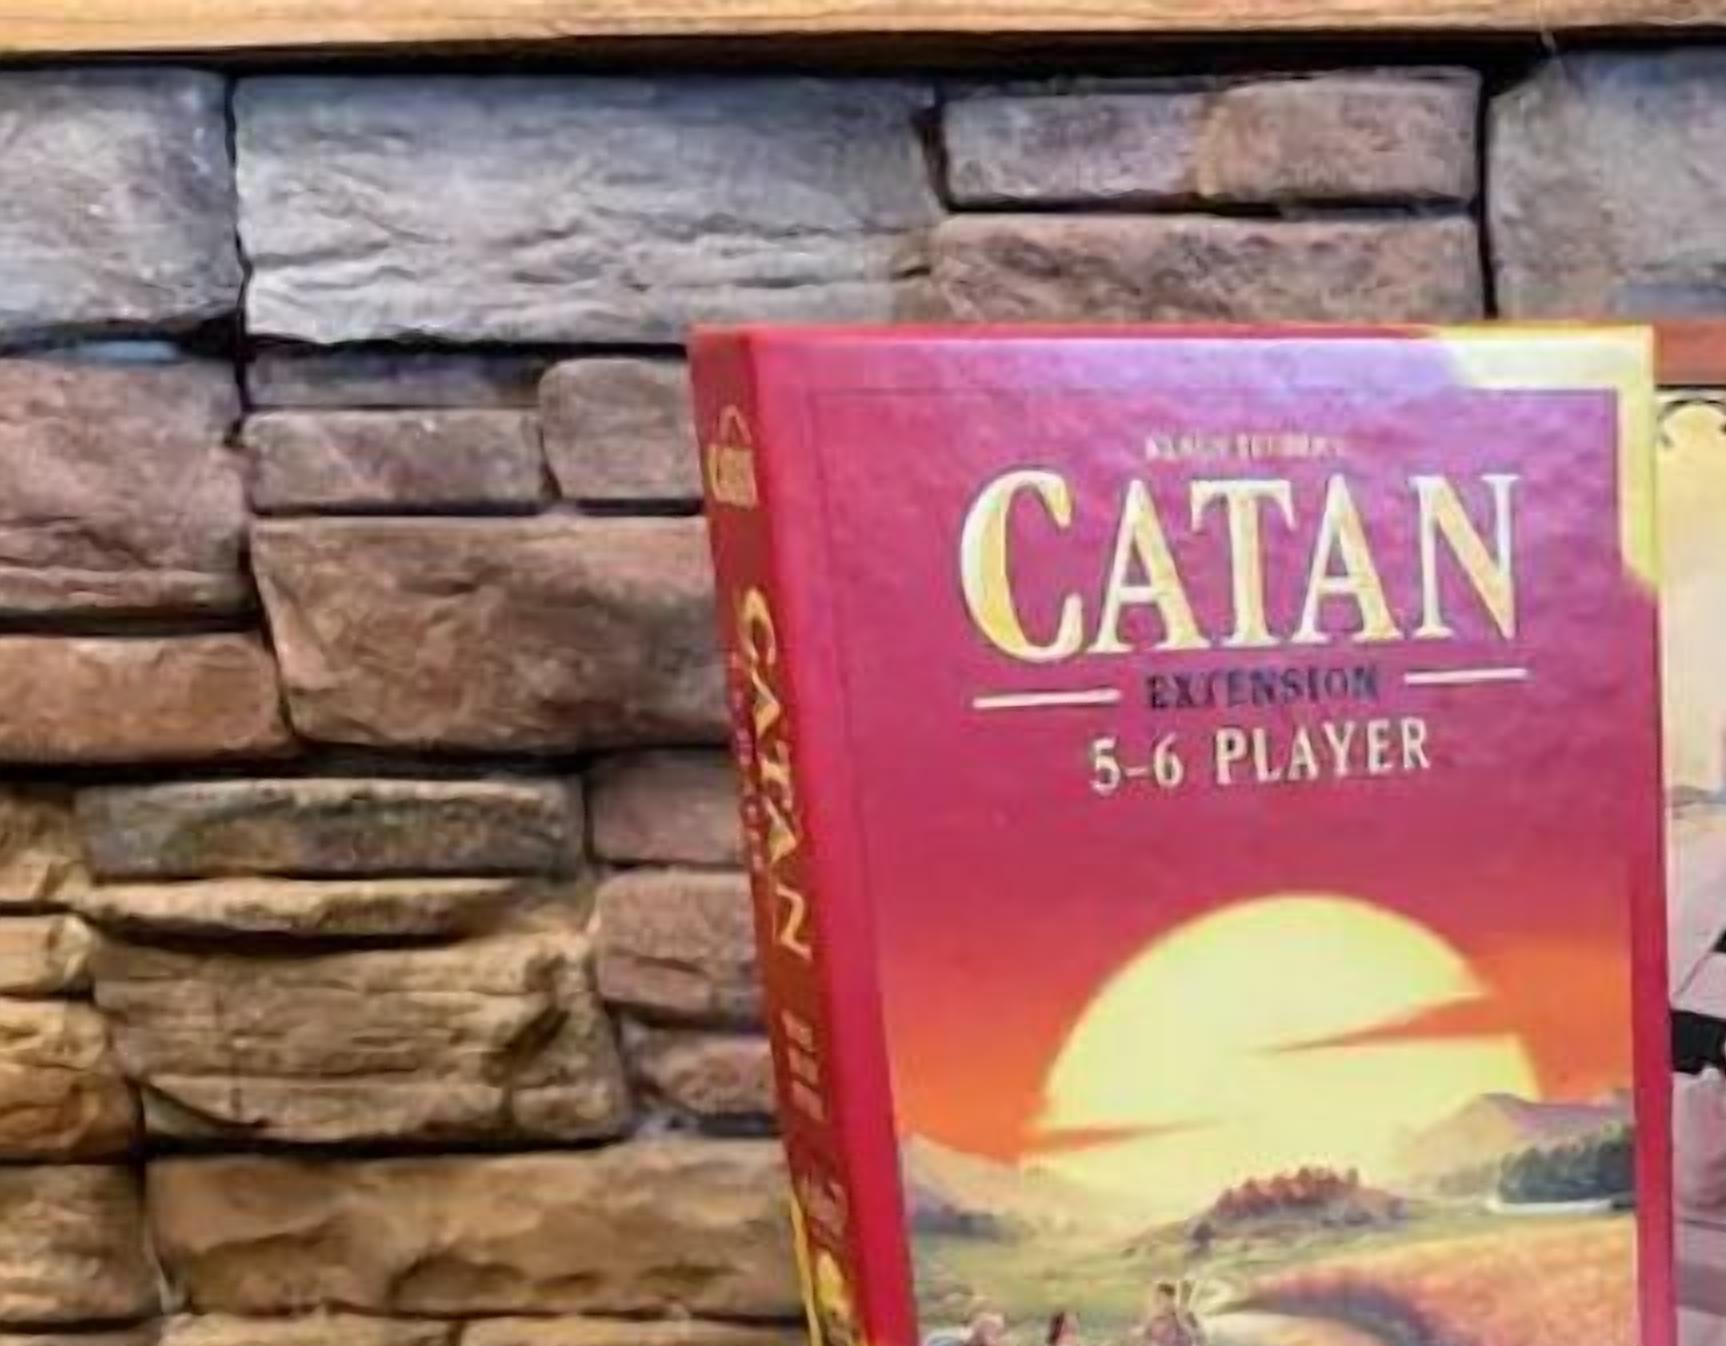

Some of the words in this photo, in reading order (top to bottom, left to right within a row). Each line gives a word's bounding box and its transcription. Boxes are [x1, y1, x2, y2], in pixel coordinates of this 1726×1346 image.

[961, 469, 1520, 661] CATAN
[1089, 732, 1185, 793] 5-6
[1214, 715, 1432, 786] PLAYER
[1147, 664, 1380, 710] EXTENSION
[738, 588, 812, 957] CATAN
